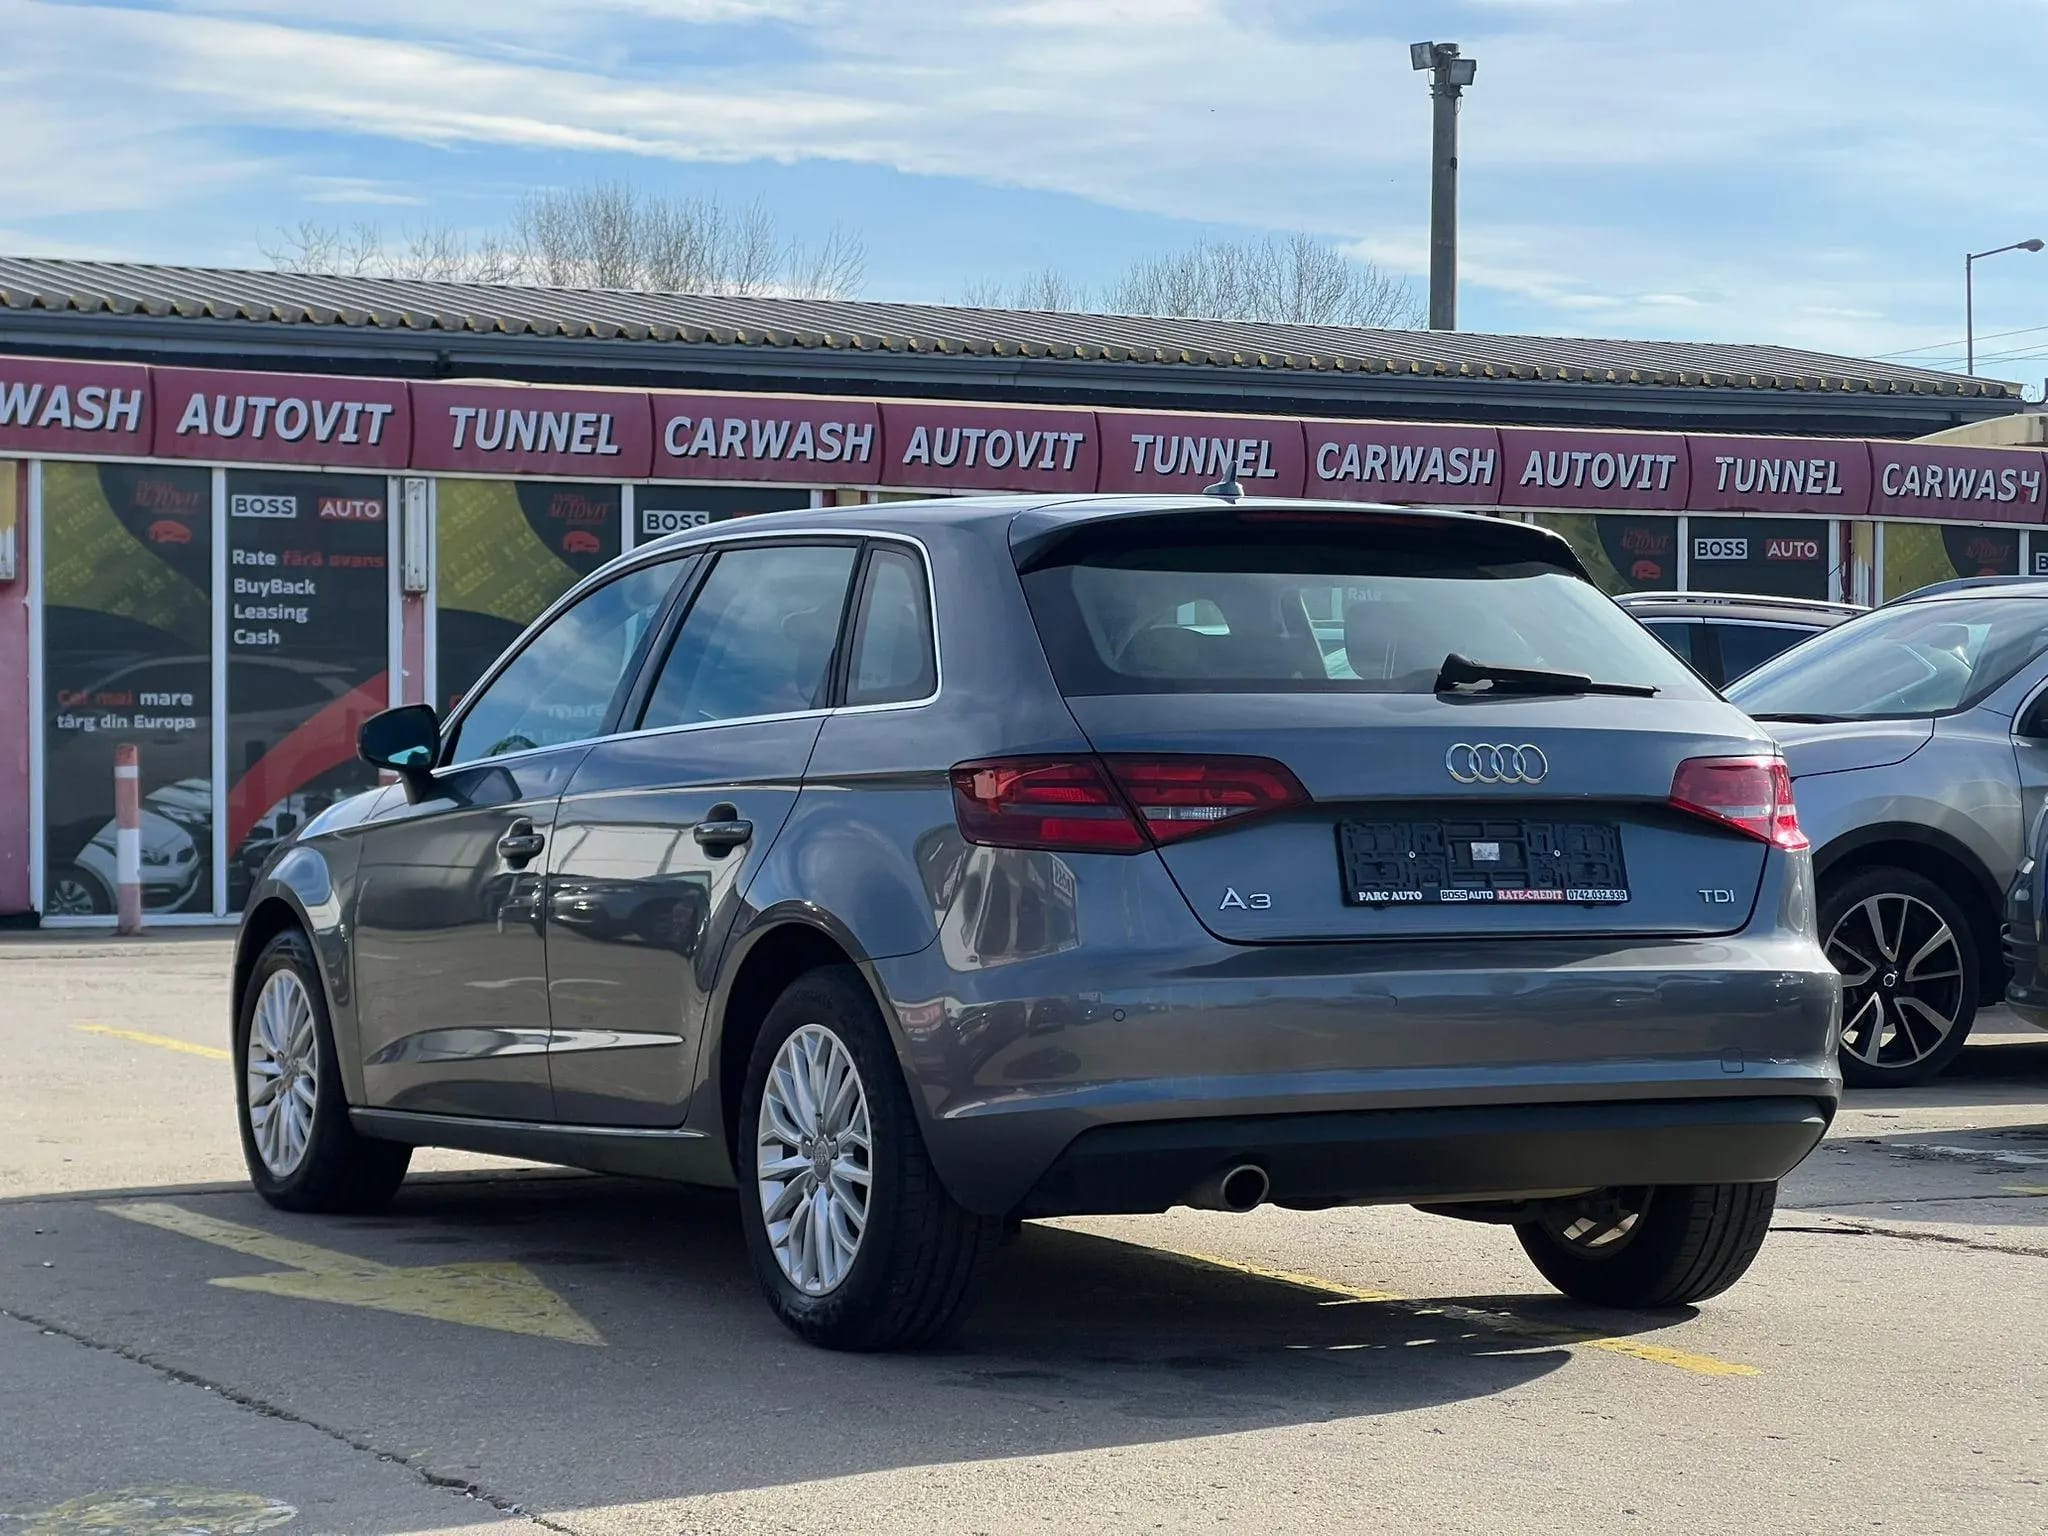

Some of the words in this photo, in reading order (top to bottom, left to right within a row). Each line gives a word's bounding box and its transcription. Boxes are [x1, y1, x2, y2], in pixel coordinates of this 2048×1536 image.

[176, 393, 393, 444] AUTOVIT
[448, 406, 622, 455] TUNNEL
[664, 416, 873, 462] CARWASH
[902, 426, 1084, 470] AUTOVIT
[1131, 434, 1277, 478] TUNNEL
[1316, 442, 1496, 486] CARWASH
[1520, 450, 1677, 490] AUTOVIT
[1715, 456, 1843, 495] TUNNEL
[1882, 463, 2041, 503] CARWASH
[235, 498, 293, 514] BOSS
[320, 500, 381, 518] AUTO
[647, 513, 706, 530] BOSS
[232, 549, 277, 566] Rate
[1698, 541, 1746, 557] BOSS
[1768, 541, 1817, 557] AUTO
[233, 578, 316, 598] BuyBack
[233, 603, 308, 623] Leasing
[233, 628, 280, 645] Cash
[139, 692, 193, 706] mare
[57, 714, 96, 732] târg
[100, 714, 128, 728] din
[133, 714, 196, 732] Europa
[1219, 887, 1272, 910] A3
[1358, 891, 1390, 901] PARC
[1391, 891, 1423, 900] AUTO
[1441, 890, 1467, 899] BOSS
[1468, 890, 1494, 900] AUTO
[1498, 890, 1563, 900] RATE-CREDIT
[1698, 889, 1735, 903] TDI
